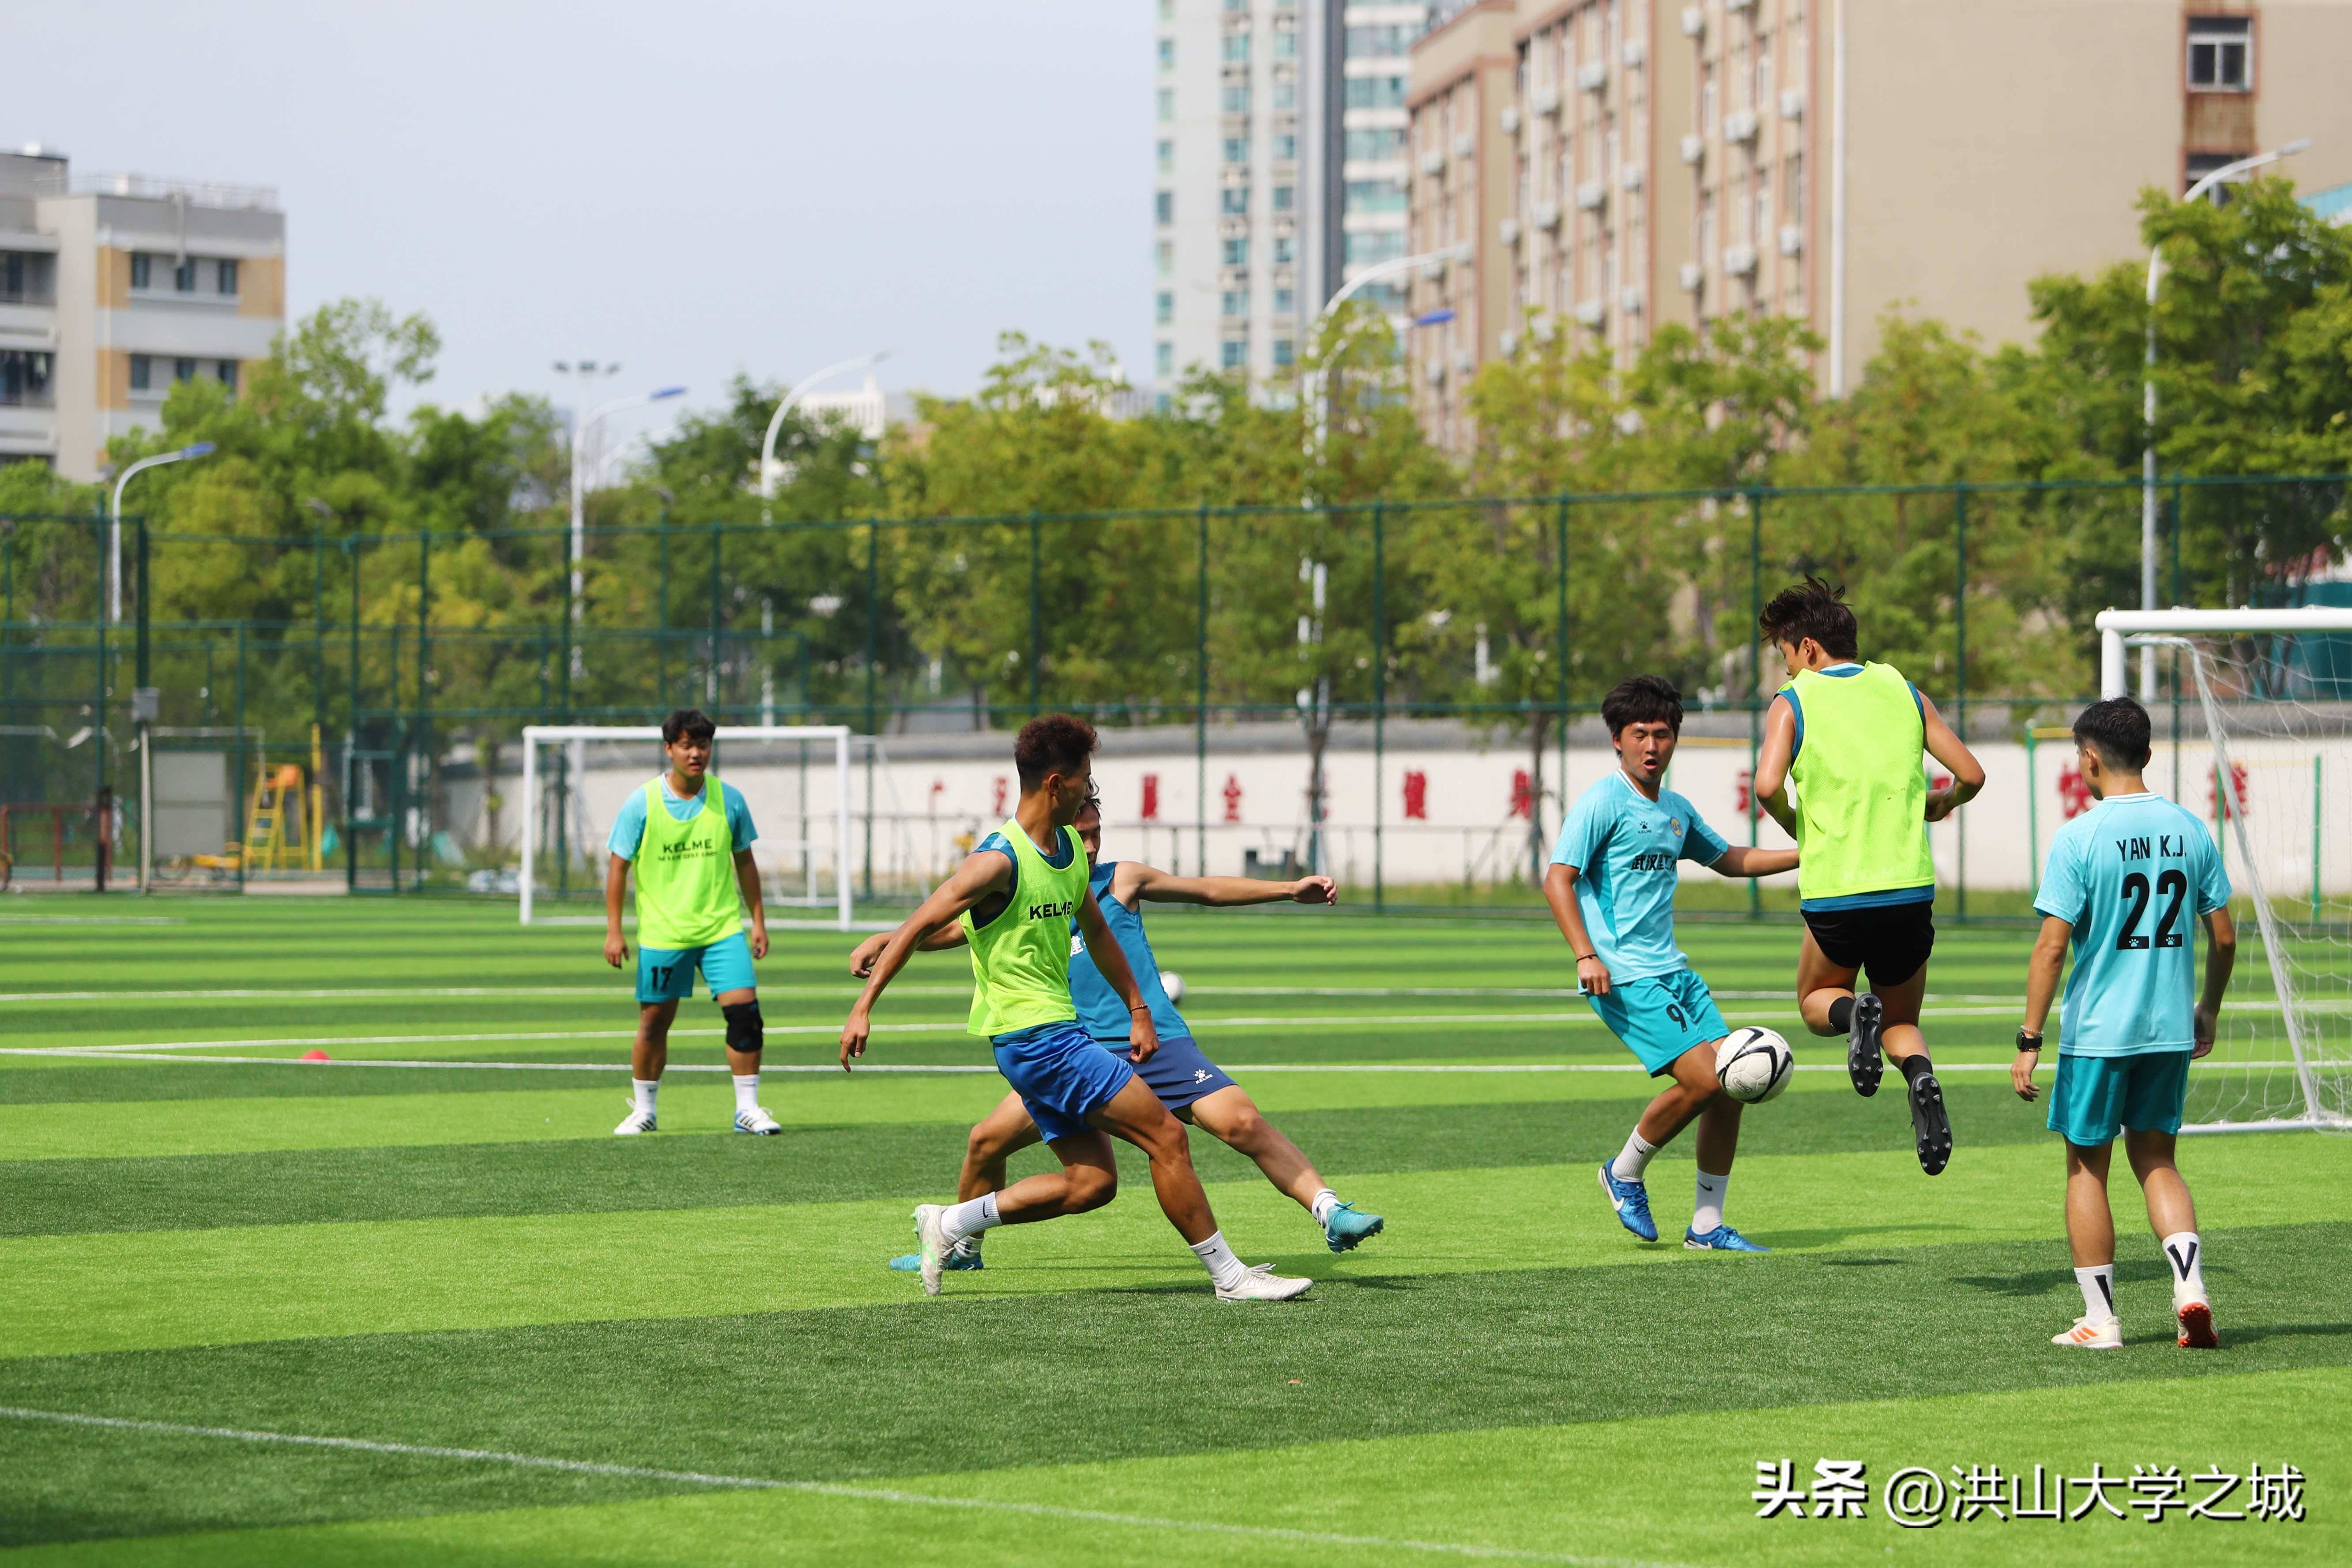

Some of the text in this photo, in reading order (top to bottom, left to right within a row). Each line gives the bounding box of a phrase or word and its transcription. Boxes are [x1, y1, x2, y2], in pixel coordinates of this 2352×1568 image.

[663, 839, 712, 853] KELME
[2116, 835, 2187, 861] YAN K.J.
[1029, 901, 1073, 920] KELME
[2116, 869, 2187, 950] 22
[651, 966, 673, 992] 17
[1666, 1004, 1688, 1033] 9
[1195, 1074, 1213, 1084] KELME
